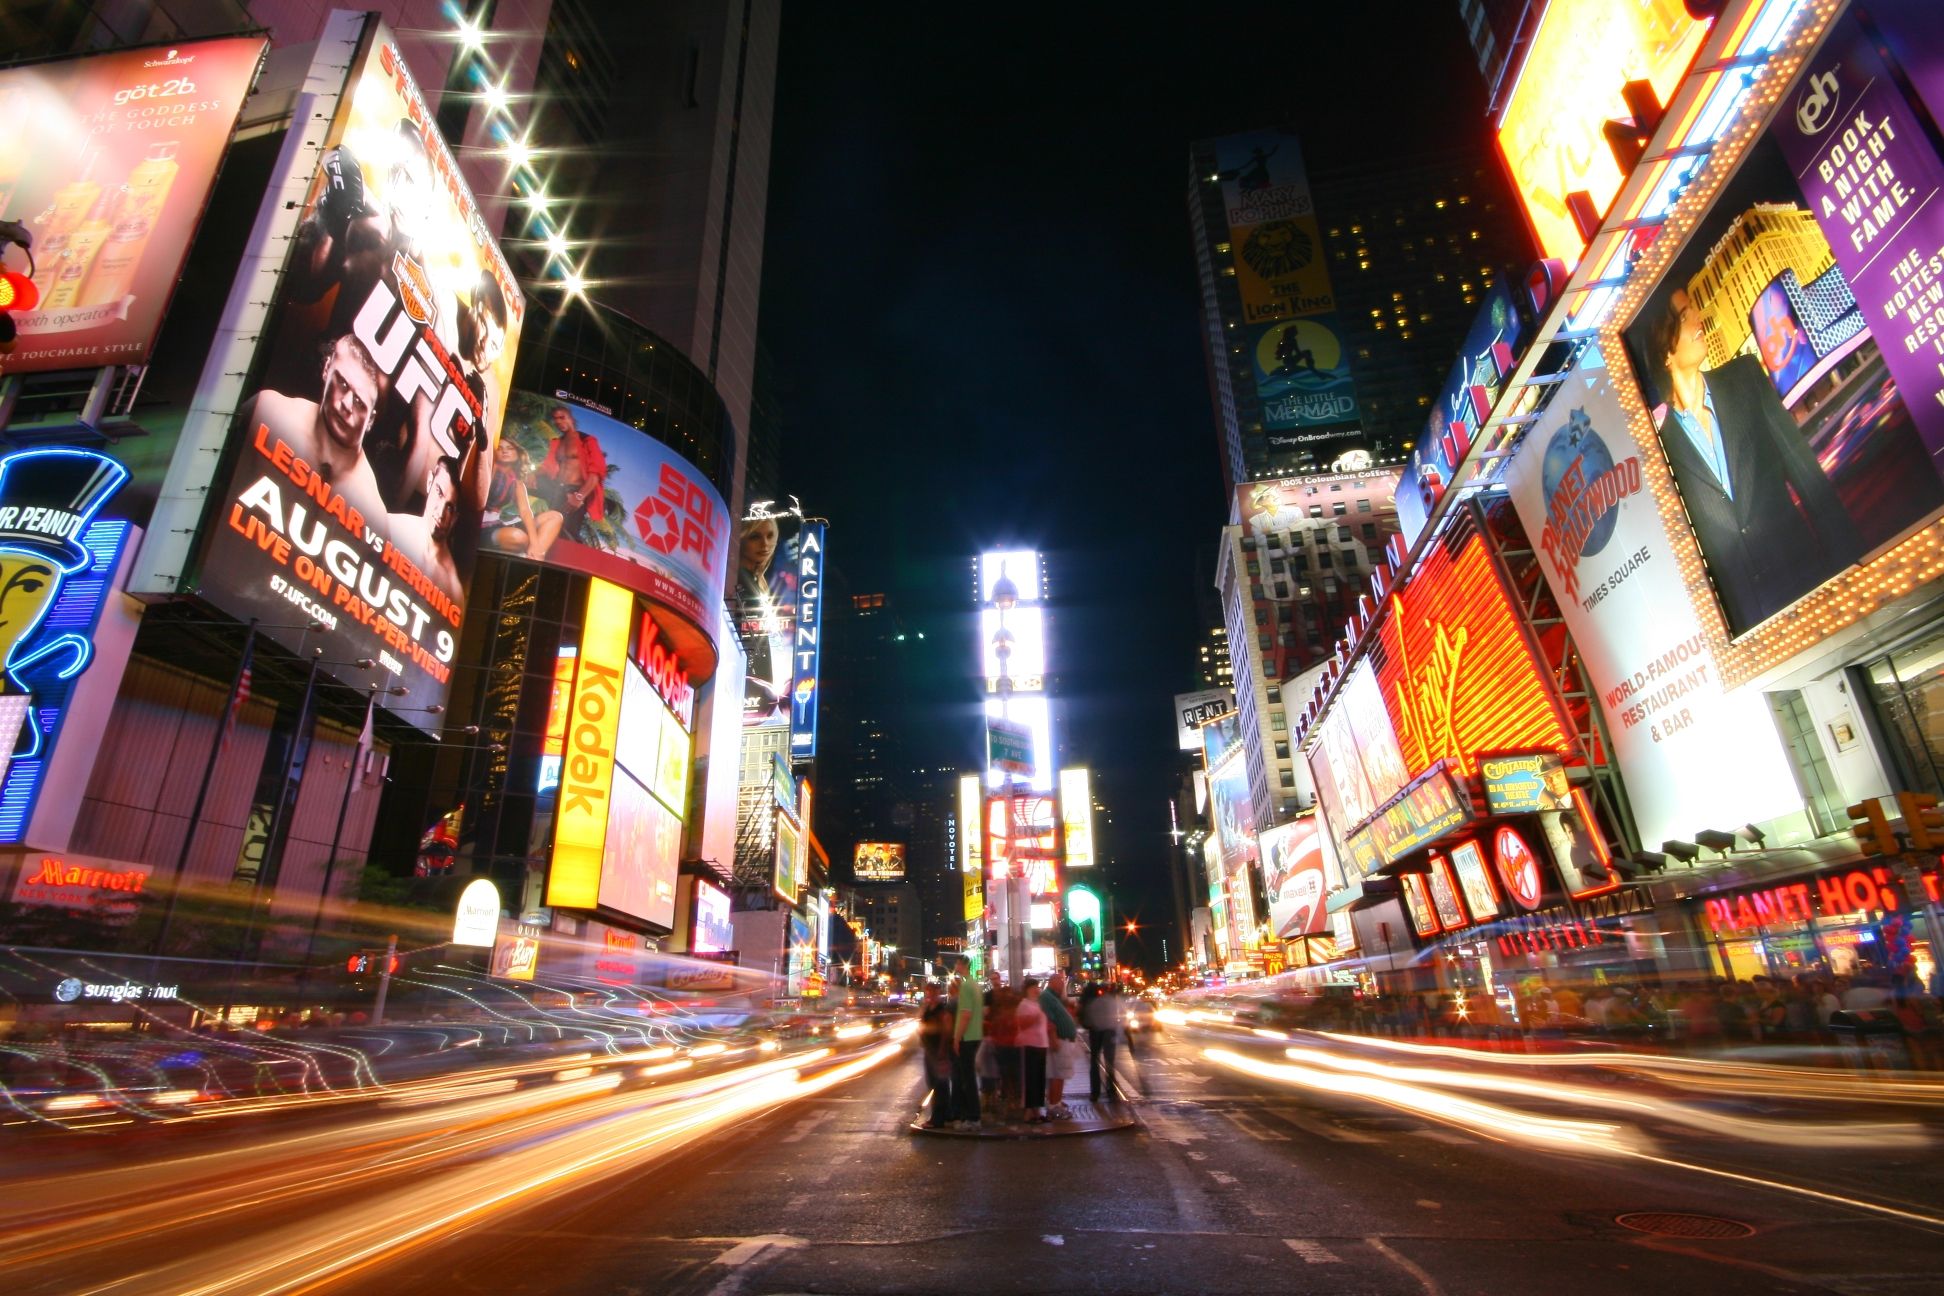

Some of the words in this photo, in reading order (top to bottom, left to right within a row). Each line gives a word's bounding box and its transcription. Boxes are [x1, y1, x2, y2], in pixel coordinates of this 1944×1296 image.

[143, 55, 196, 68] Schwarzkopf
[391, 42, 423, 106] WORLD
[91, 122, 121, 136] OF
[127, 115, 195, 130] TOUCH
[126, 100, 221, 118] GODDESS
[1817, 109, 1875, 185] BOOK
[1820, 193, 1836, 219] A
[1833, 115, 1897, 200] NIGHT
[1230, 195, 1312, 225] POPPINS
[1240, 185, 1296, 209] MARY
[1840, 158, 1896, 227] WITH
[1850, 179, 1918, 253] FAME.
[1704, 214, 1743, 269] planet
[1890, 247, 1923, 286] THE
[1246, 302, 1287, 321] LION
[1289, 295, 1333, 316] KING
[1271, 281, 1300, 295] THE
[1906, 280, 1944, 326] NEW
[53, 309, 113, 329] operator
[22, 346, 101, 360] TOUCHABLE
[103, 342, 144, 354] STYLE
[352, 278, 474, 459] UFC
[423, 326, 483, 418] PRESENTS
[1264, 396, 1355, 423] MERMAID
[1304, 392, 1337, 405] LITTLE
[1280, 478, 1303, 488] 100%
[1305, 471, 1357, 485] Colombian
[1358, 468, 1391, 480] Coffee
[14, 507, 83, 540] PEANUT
[254, 423, 365, 539] LESNAR
[364, 525, 385, 553] VS
[382, 541, 462, 629] HERRING
[1540, 453, 1588, 560] PLANET
[1553, 455, 1644, 606] HOLLYWOOD
[228, 503, 292, 566] LIVE
[294, 554, 333, 596] ON
[334, 583, 452, 686] PAY-PER-VIEW
[238, 475, 431, 641] AUGUST
[434, 630, 454, 664] 9
[1582, 582, 1609, 614] TIMES
[1608, 545, 1652, 592] SQUARE
[269, 574, 338, 631] 87.UFC.COM
[797, 531, 821, 672] ARGENT
[639, 610, 691, 725] Kodak
[1605, 630, 1710, 709] WORLD-FAMOUS
[1184, 703, 1225, 724] RENT
[1620, 664, 1710, 729] RESTAURANT
[565, 660, 622, 817] Kodak
[1650, 724, 1663, 744] &
[1663, 707, 1695, 739] BAR
[948, 818, 956, 871] NOVOTEL
[27, 857, 147, 893] Marriott
[1705, 883, 1813, 933] PLANET
